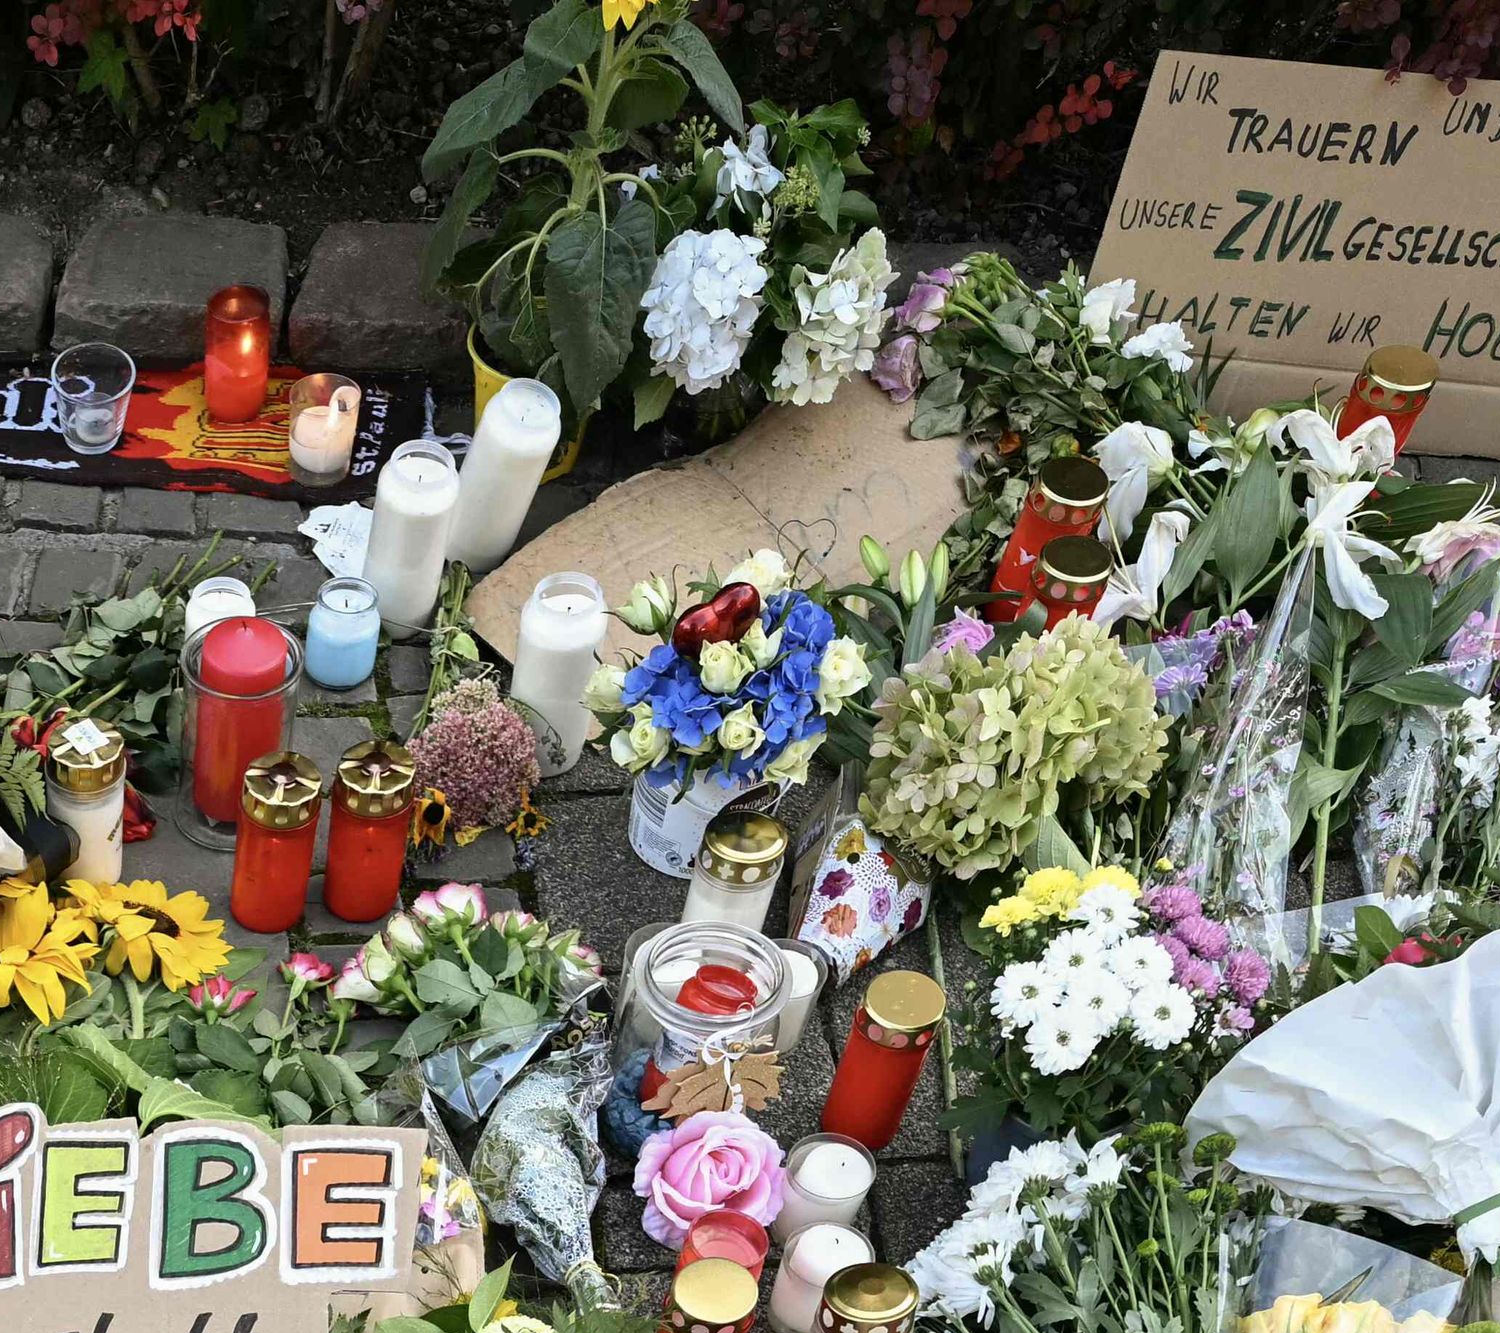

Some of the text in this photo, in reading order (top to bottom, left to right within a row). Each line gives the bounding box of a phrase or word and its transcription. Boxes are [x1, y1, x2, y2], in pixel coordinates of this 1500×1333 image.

[1168, 61, 1219, 105] WIR
[1227, 107, 1419, 166] TRAUERN
[1119, 198, 1223, 232] UNSERE
[1136, 288, 1310, 341] HALTEN
[1328, 311, 1379, 347] WIR
